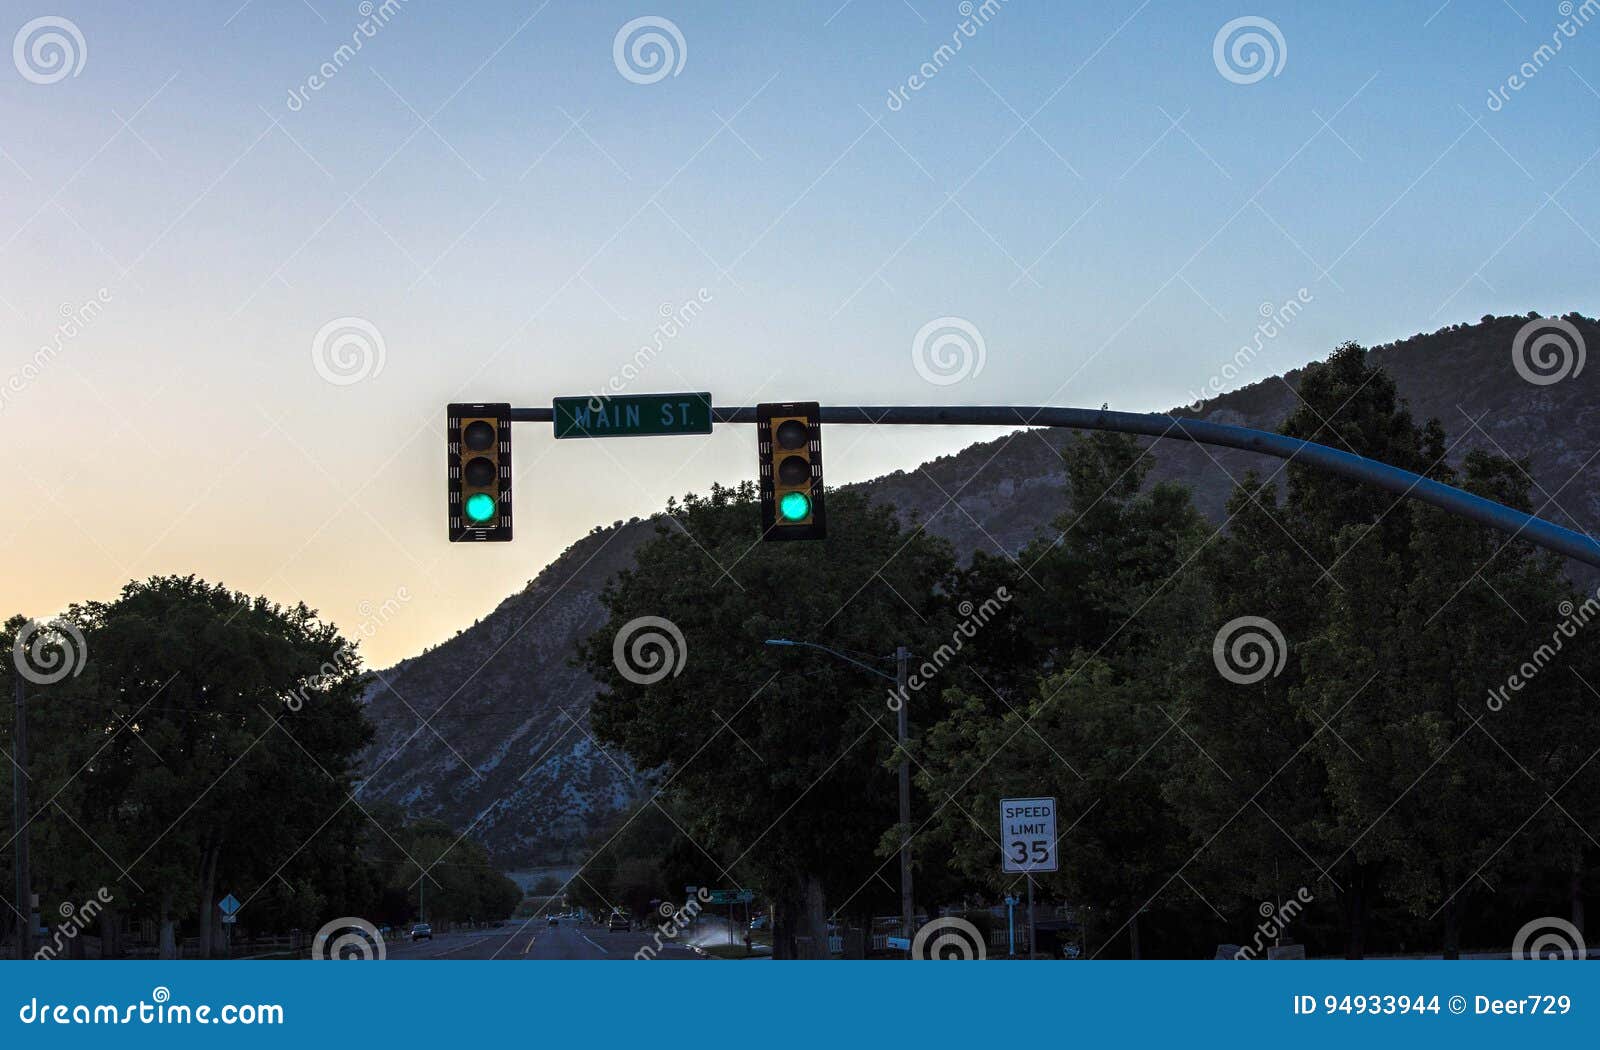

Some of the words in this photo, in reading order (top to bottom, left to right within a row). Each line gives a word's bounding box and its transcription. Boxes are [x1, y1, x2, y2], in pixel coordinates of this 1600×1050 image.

[575, 404, 640, 428] MAIN
[661, 402, 694, 426] ST.
[1006, 807, 1051, 819] SPEED
[1011, 823, 1046, 835] LIMIT
[1011, 841, 1050, 864] 35
